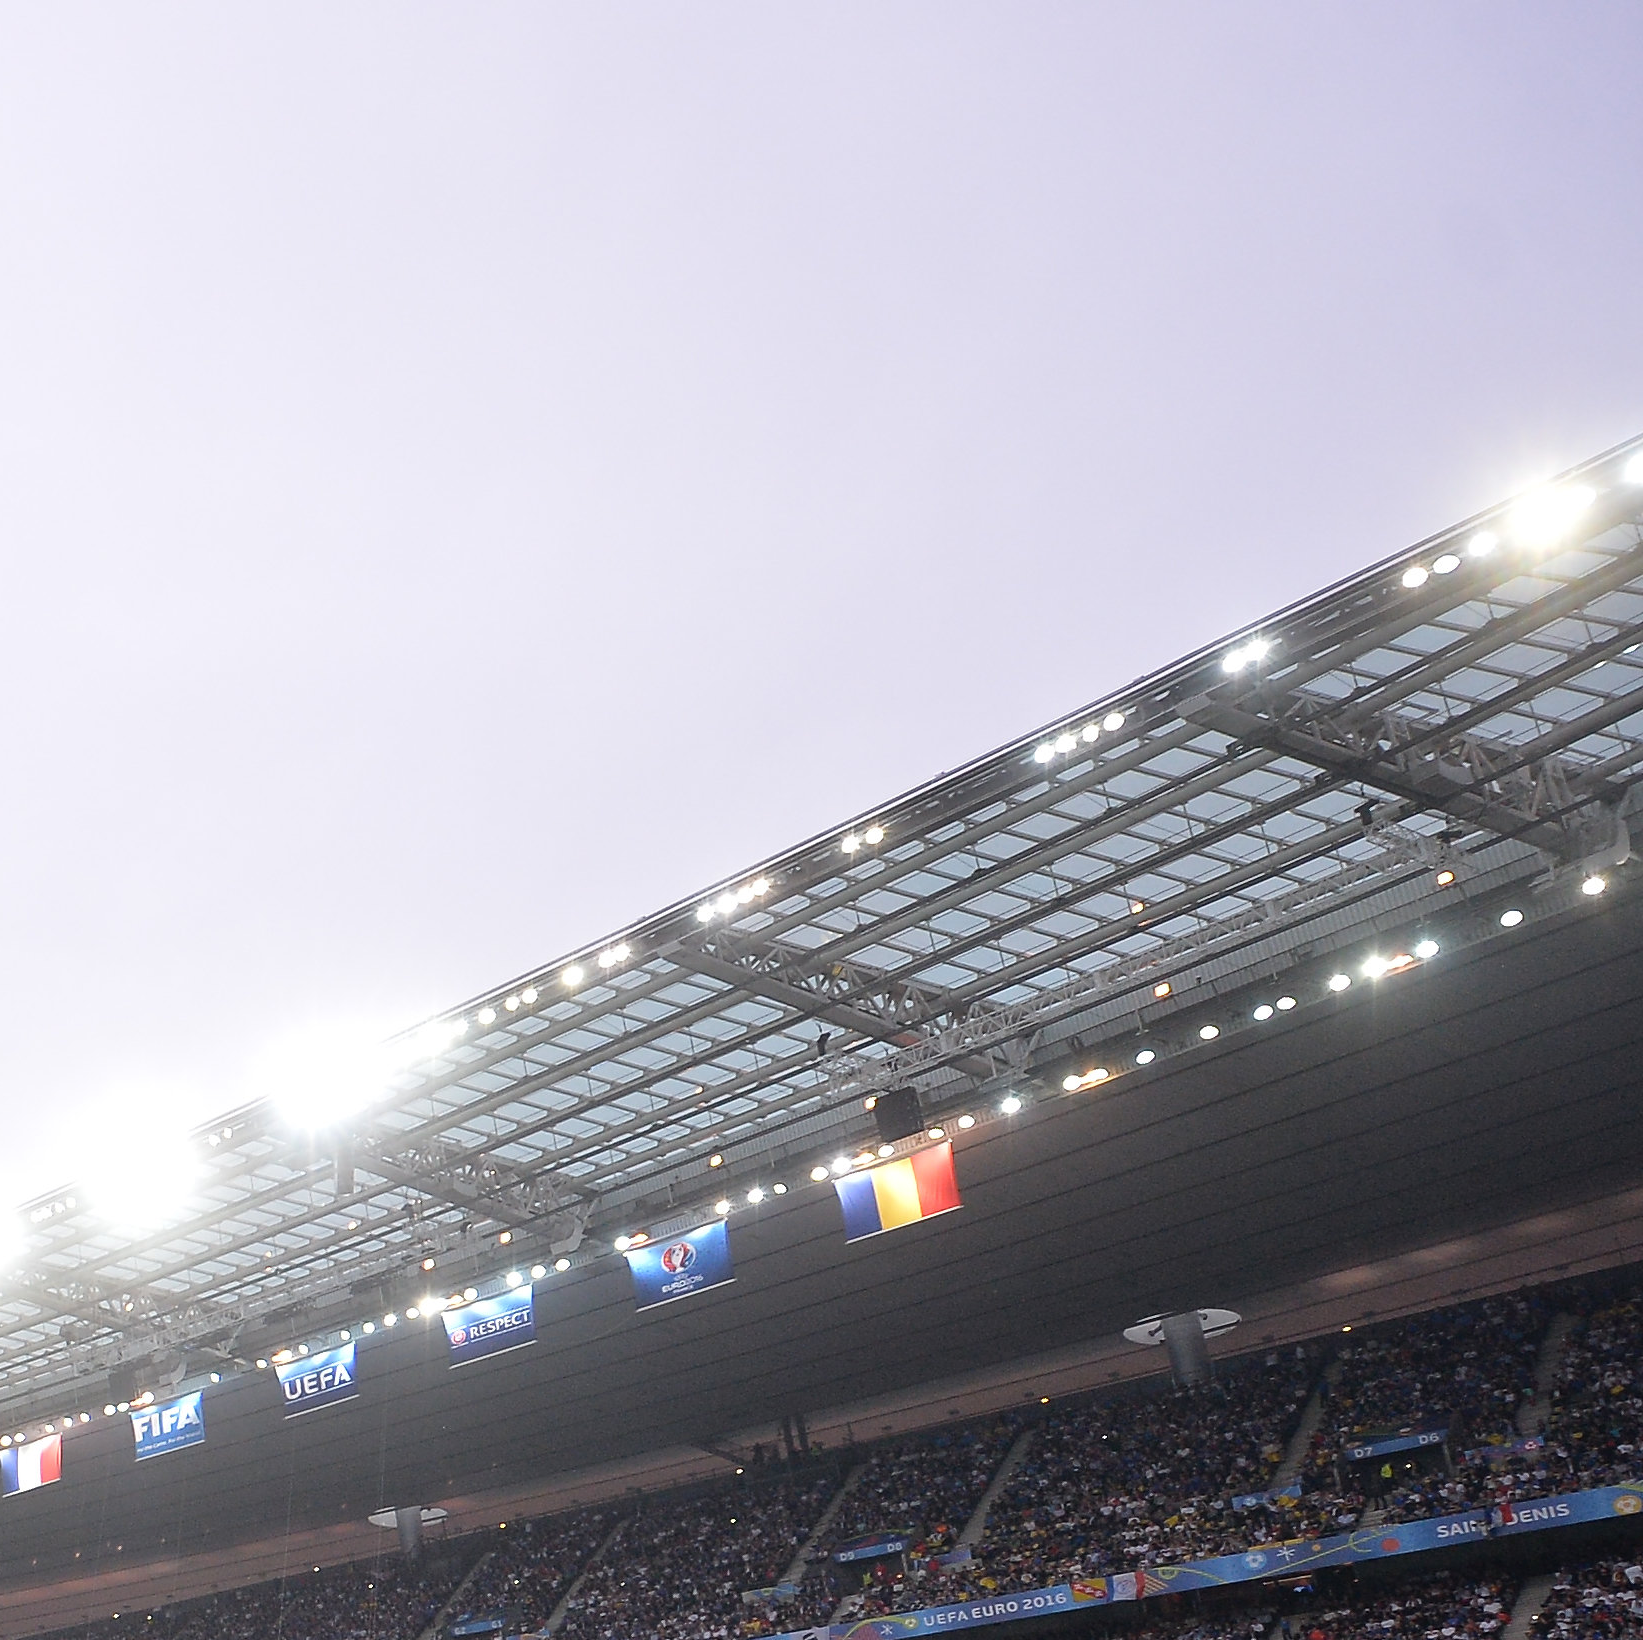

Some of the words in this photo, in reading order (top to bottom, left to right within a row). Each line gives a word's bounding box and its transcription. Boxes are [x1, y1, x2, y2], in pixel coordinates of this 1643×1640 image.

[470, 1310, 531, 1339] RESPECT
[284, 1363, 351, 1400] UEFA
[133, 1401, 200, 1443] FIFA
[1354, 1447, 1373, 1458] D7
[1419, 1432, 1439, 1444] D6
[923, 1611, 968, 1626] UEFA
[972, 1601, 1018, 1619] EURO
[1023, 1593, 1067, 1610] 2016
